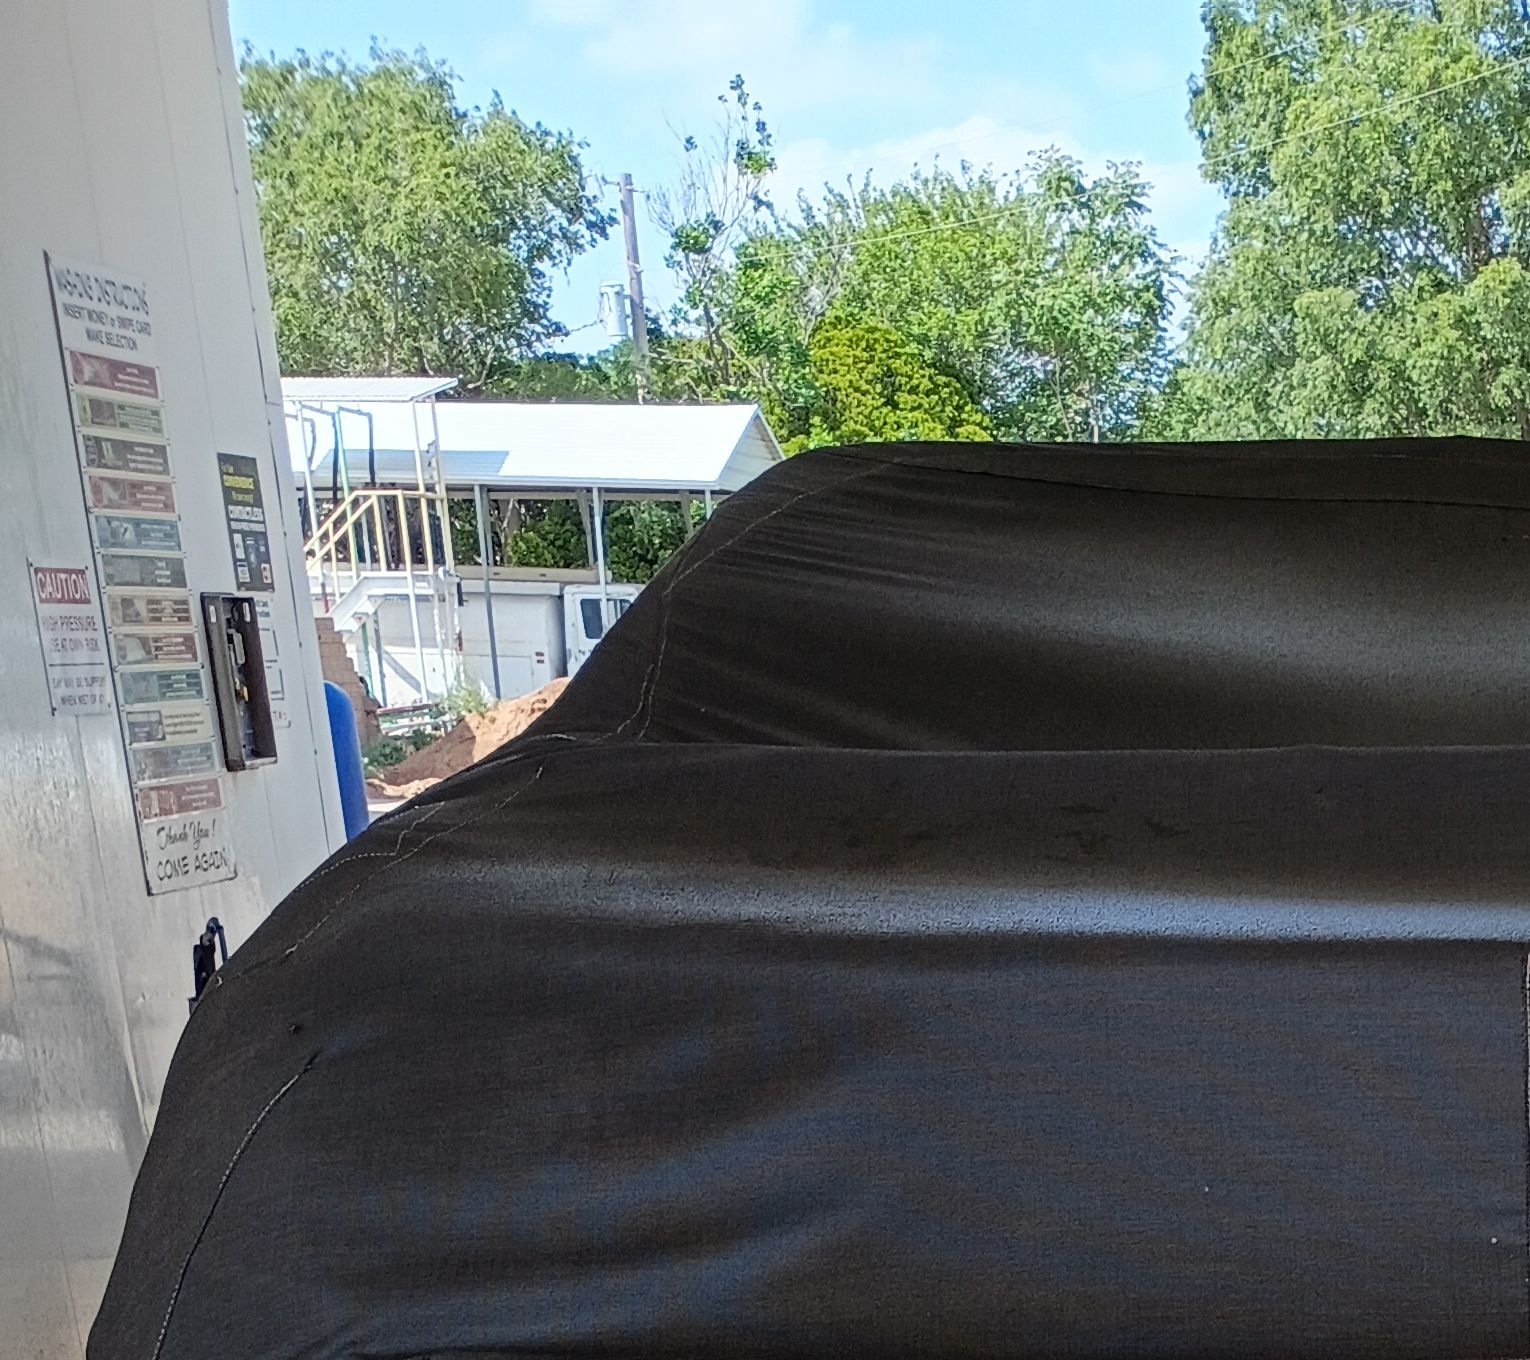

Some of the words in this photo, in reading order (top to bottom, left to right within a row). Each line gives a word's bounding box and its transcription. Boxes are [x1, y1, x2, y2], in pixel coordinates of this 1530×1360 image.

[36, 572, 90, 600] CAUTION
[59, 615, 98, 631] PRESSURE
[156, 824, 188, 850] Thank
[157, 856, 189, 881] COME
[194, 847, 227, 872] AGAIN
